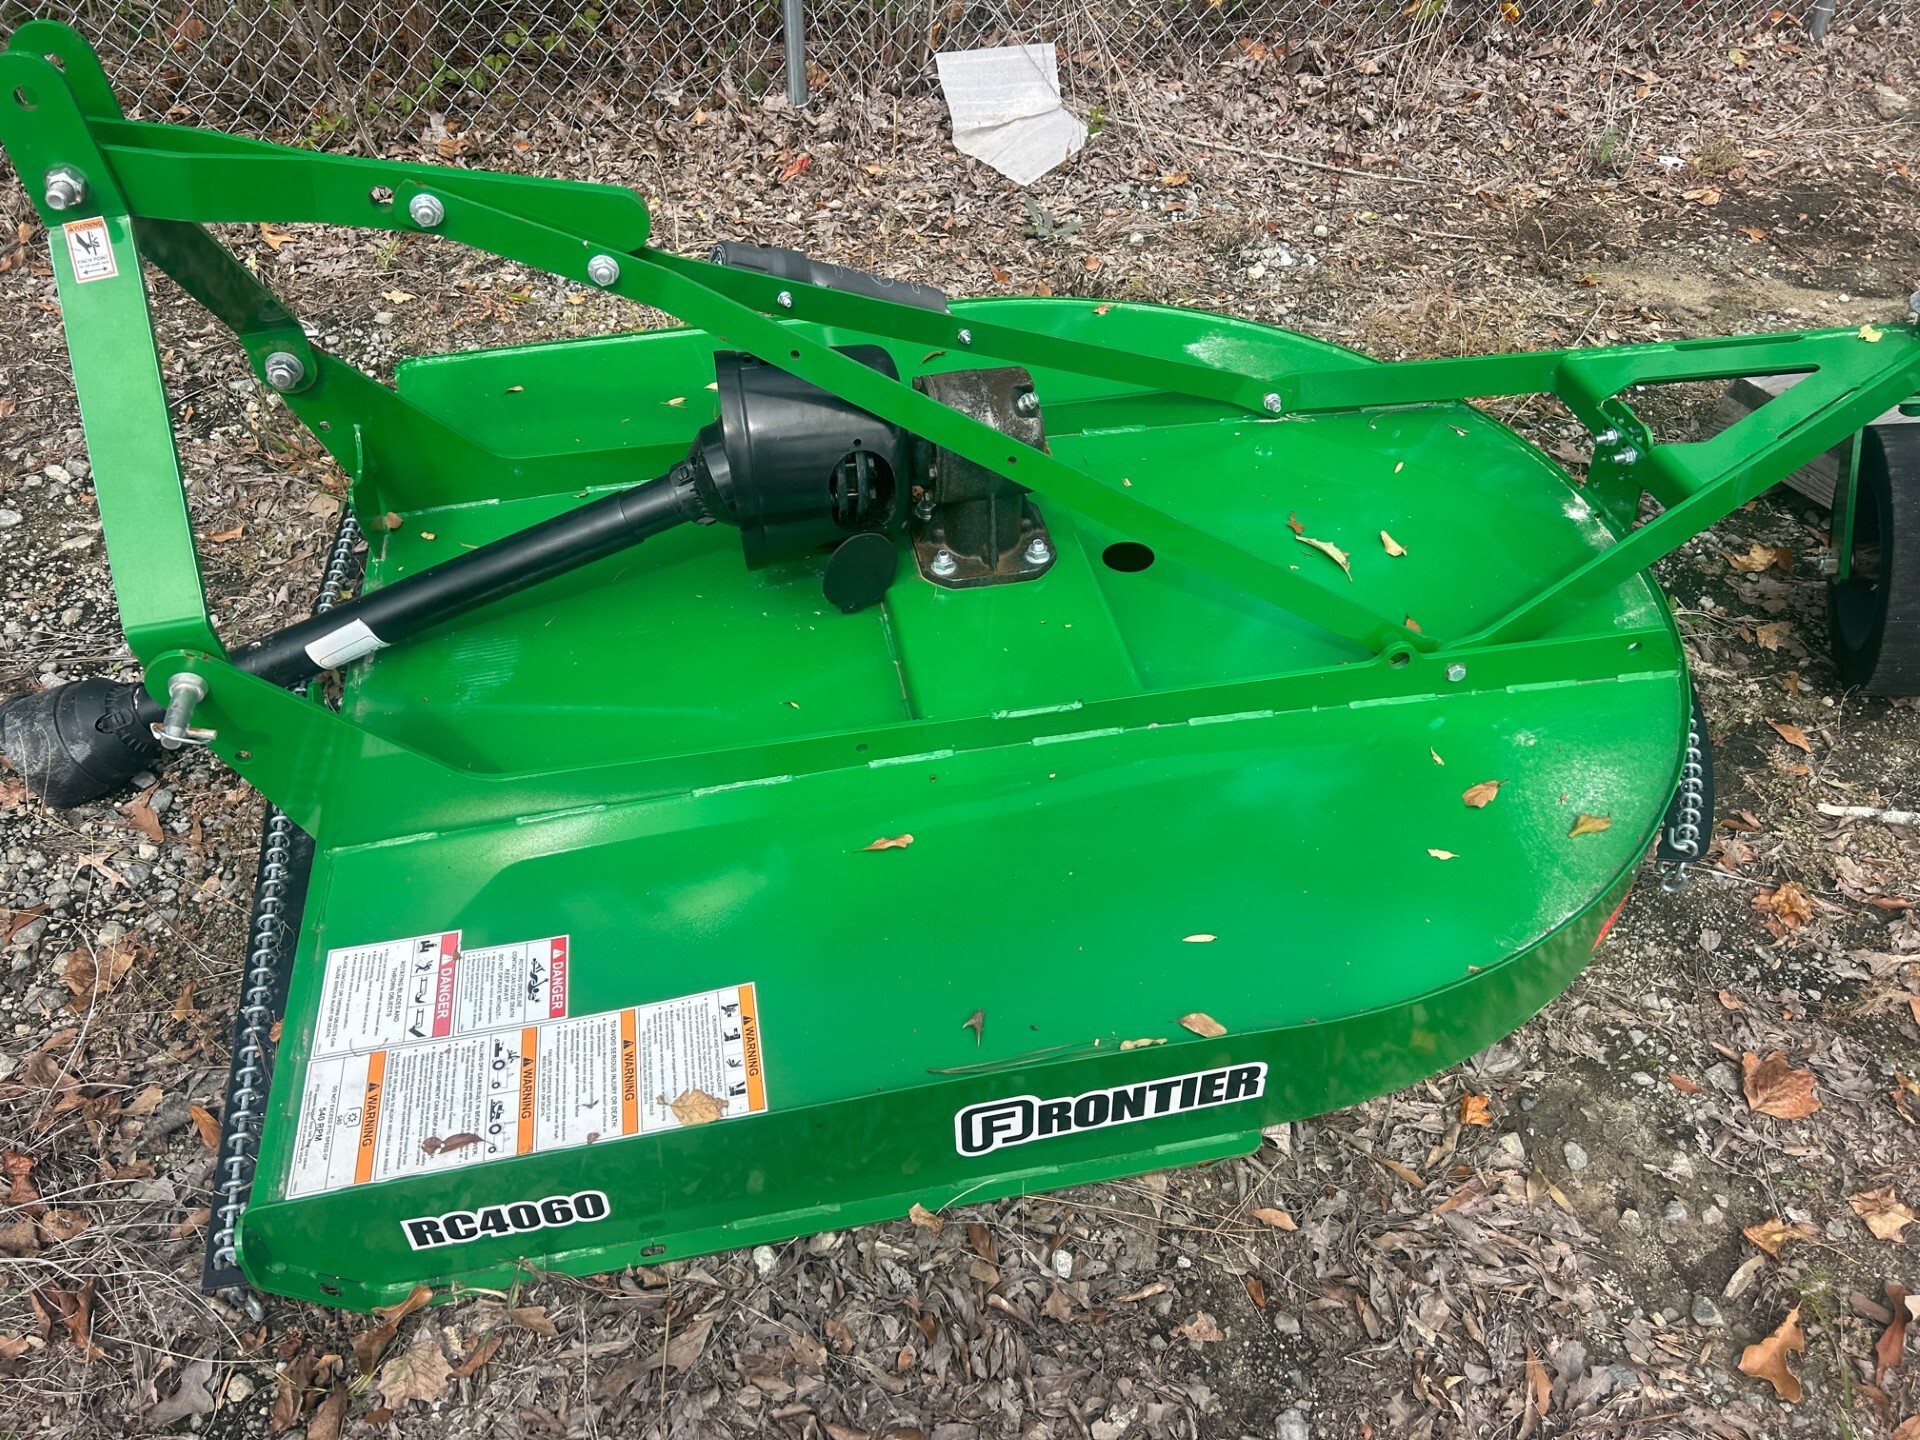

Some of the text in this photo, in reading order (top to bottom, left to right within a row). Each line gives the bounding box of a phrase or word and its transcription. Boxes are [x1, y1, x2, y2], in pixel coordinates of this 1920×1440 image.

[74, 221, 103, 230] WARNING
[397, 960, 405, 986] ROTATING
[436, 967, 452, 1019] DANGER
[551, 961, 563, 1009] DANGER
[386, 991, 394, 1016] OBJECTS
[610, 1020, 615, 1028] TO
[624, 1050, 633, 1101] WARNING
[745, 1026, 758, 1076] WARNING
[521, 1068, 532, 1118] WARNING
[611, 1095, 616, 1105] OR
[959, 1064, 1264, 1155] FRONTIER
[314, 1106, 326, 1141] 540 RPM
[361, 1094, 378, 1146] WARNING
[405, 1192, 607, 1248] RC4060
